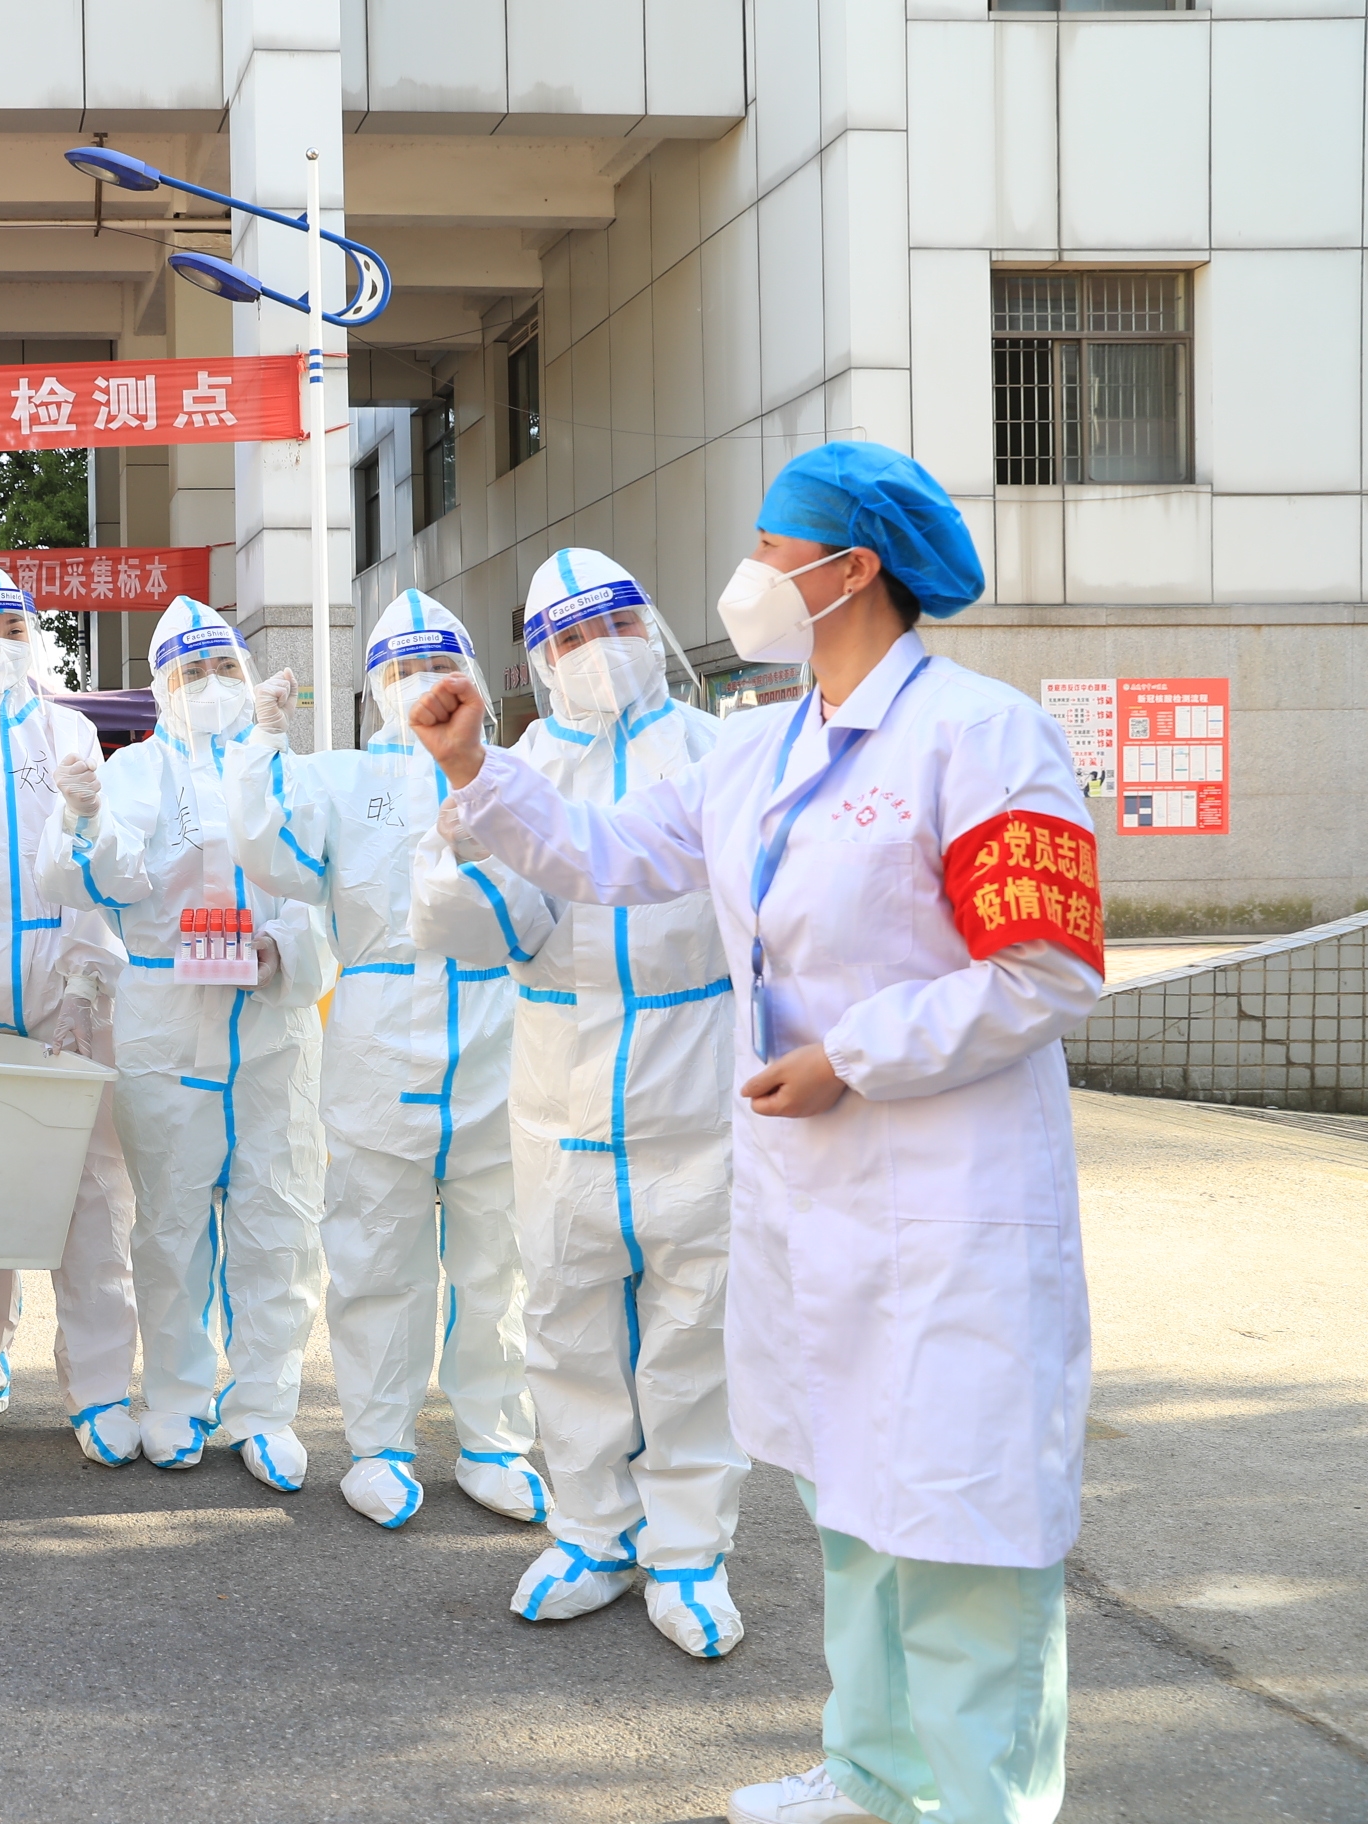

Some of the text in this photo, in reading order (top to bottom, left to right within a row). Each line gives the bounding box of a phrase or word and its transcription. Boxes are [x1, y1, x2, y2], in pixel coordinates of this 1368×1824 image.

[0, 592, 22, 600] Shield
[552, 603, 576, 618] Face
[578, 590, 610, 607] Shield
[186, 633, 206, 642] Face
[391, 638, 411, 646] Face
[413, 634, 440, 643] Shield
[1003, 820, 1098, 890] 党员志愿
